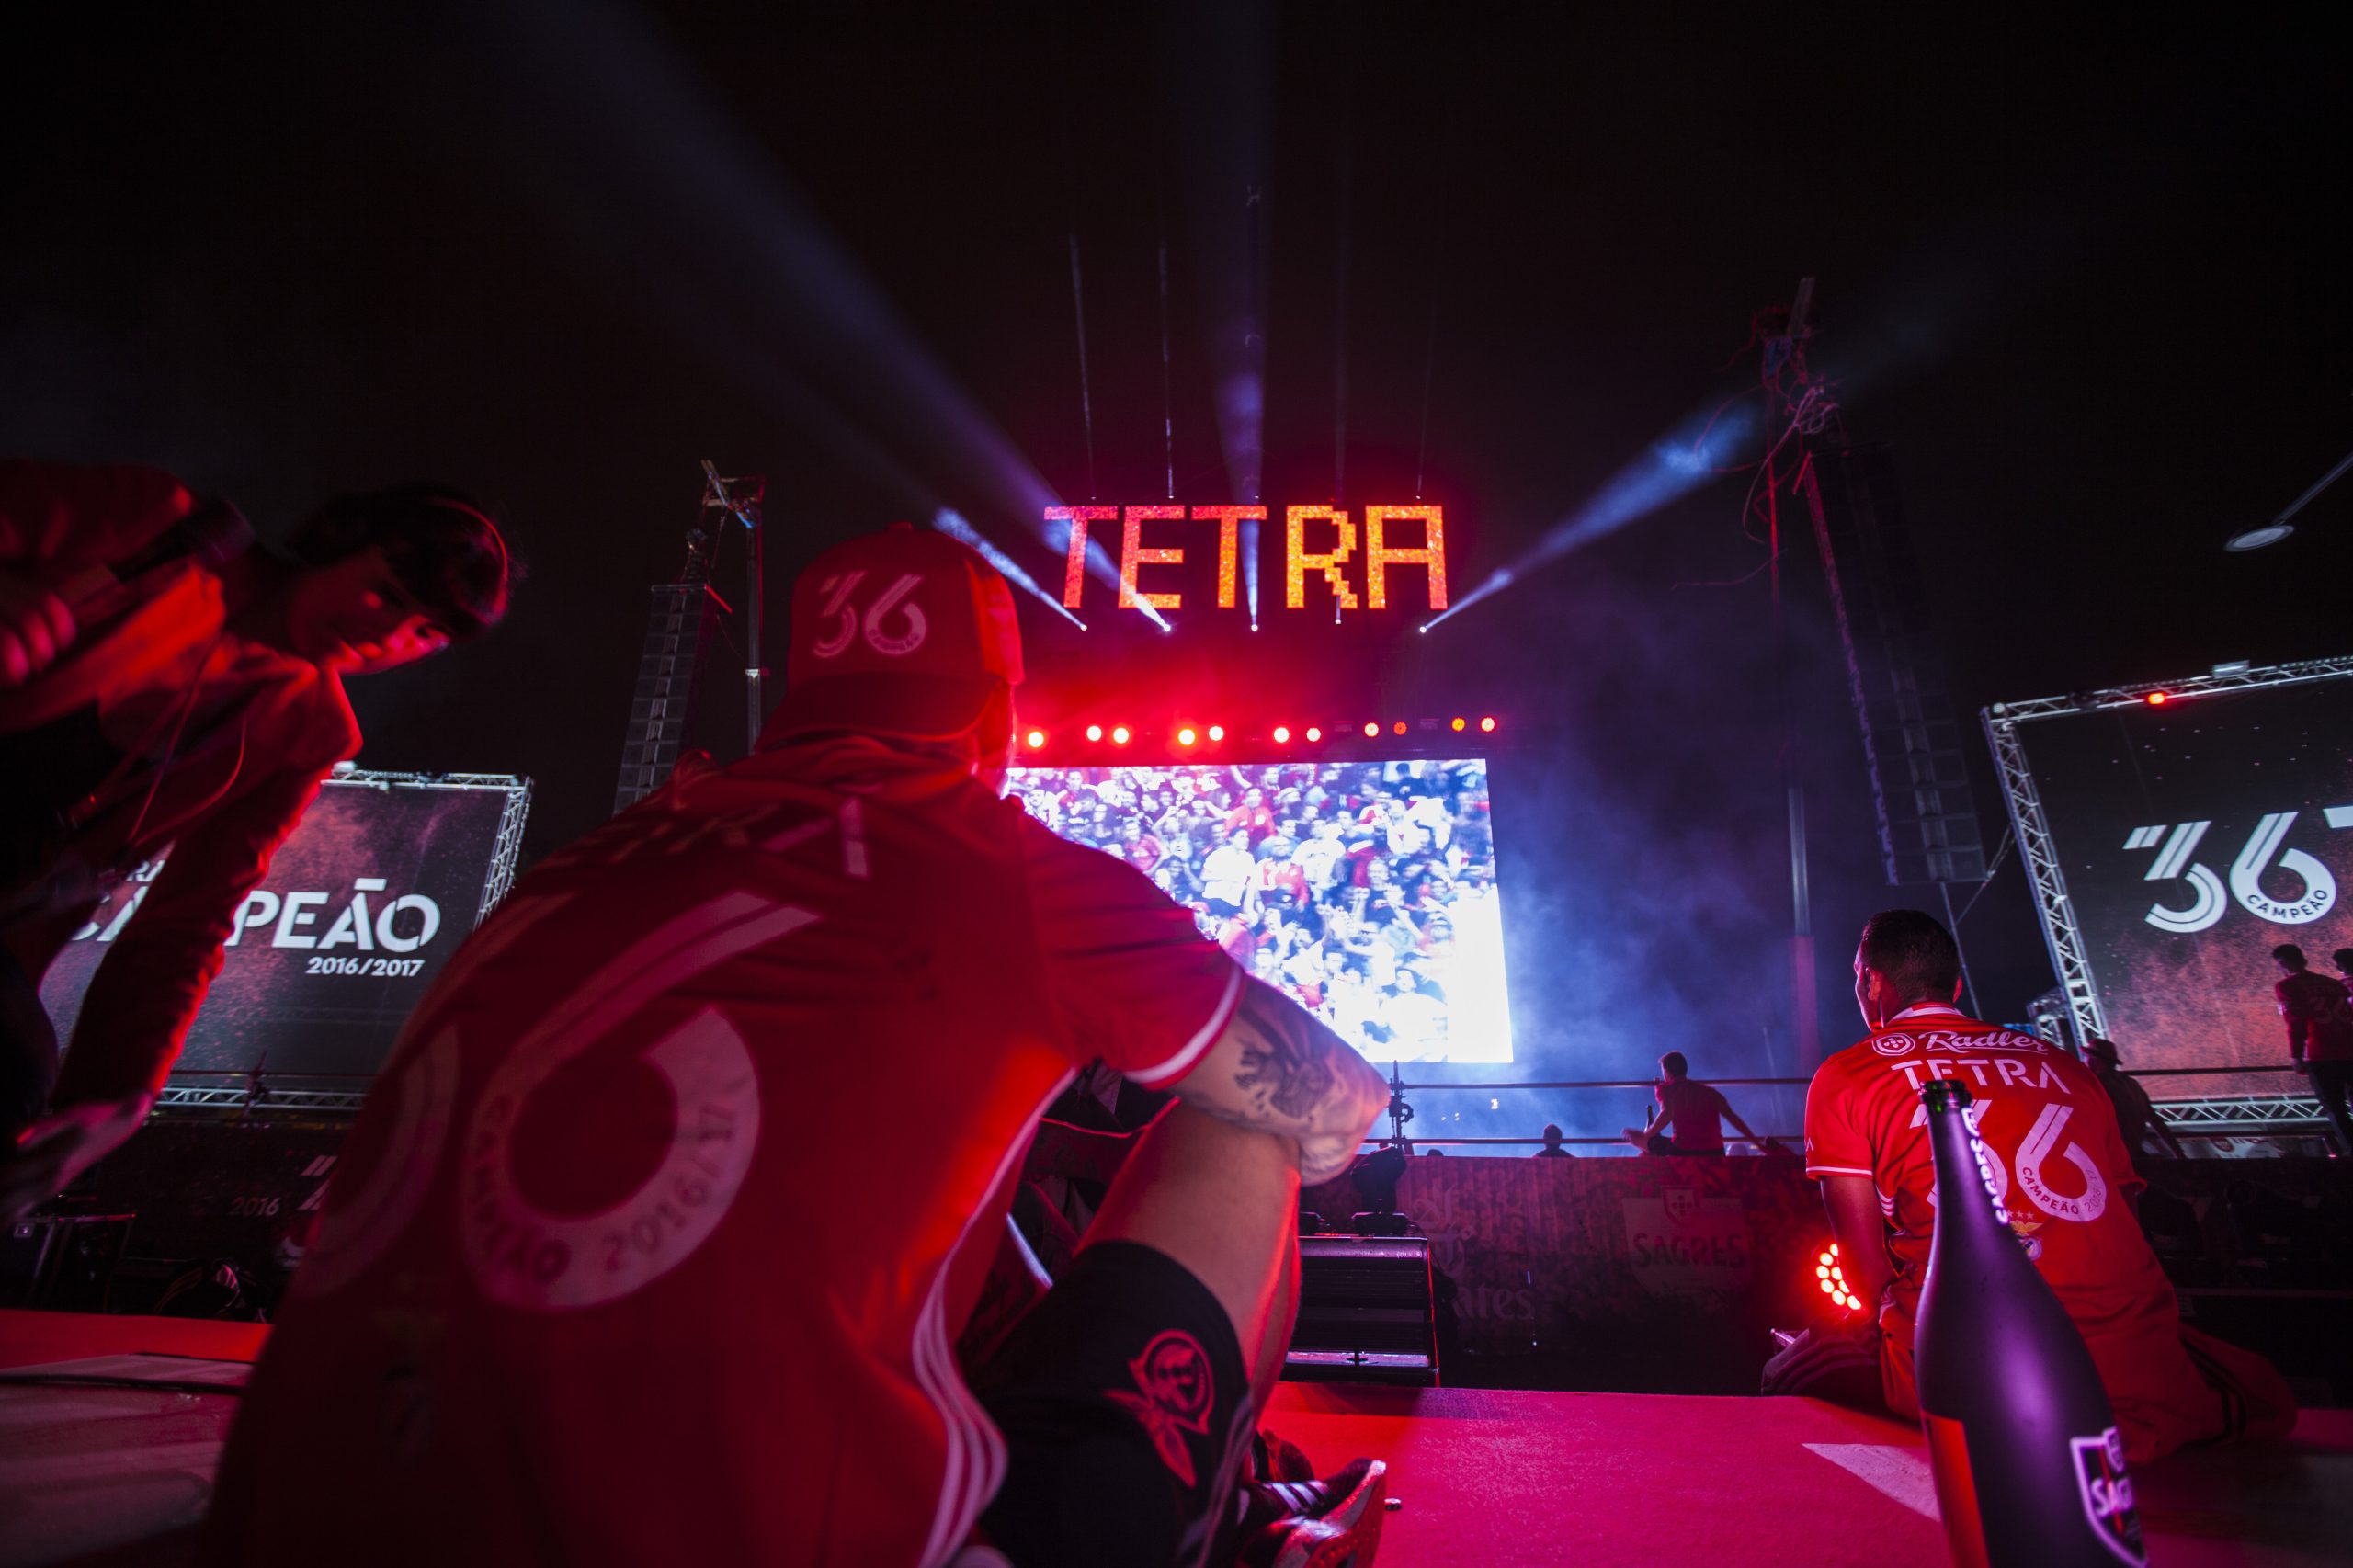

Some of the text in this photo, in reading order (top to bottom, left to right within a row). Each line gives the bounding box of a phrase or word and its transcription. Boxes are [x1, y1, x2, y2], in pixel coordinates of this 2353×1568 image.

[1044, 505, 1449, 609] TETRA
[813, 570, 926, 658] 36
[2122, 812, 2337, 934] 36
[2246, 889, 2328, 919] CAMPEÃO
[306, 956, 426, 979] 2016/2017
[1917, 1030, 2049, 1055] Radler
[1890, 1058, 2072, 1094] TETRA
[228, 1196, 281, 1218] 2016
[2021, 1166, 2080, 1215] CAMPEÃO
[1632, 1232, 1746, 1269] SAGRES
